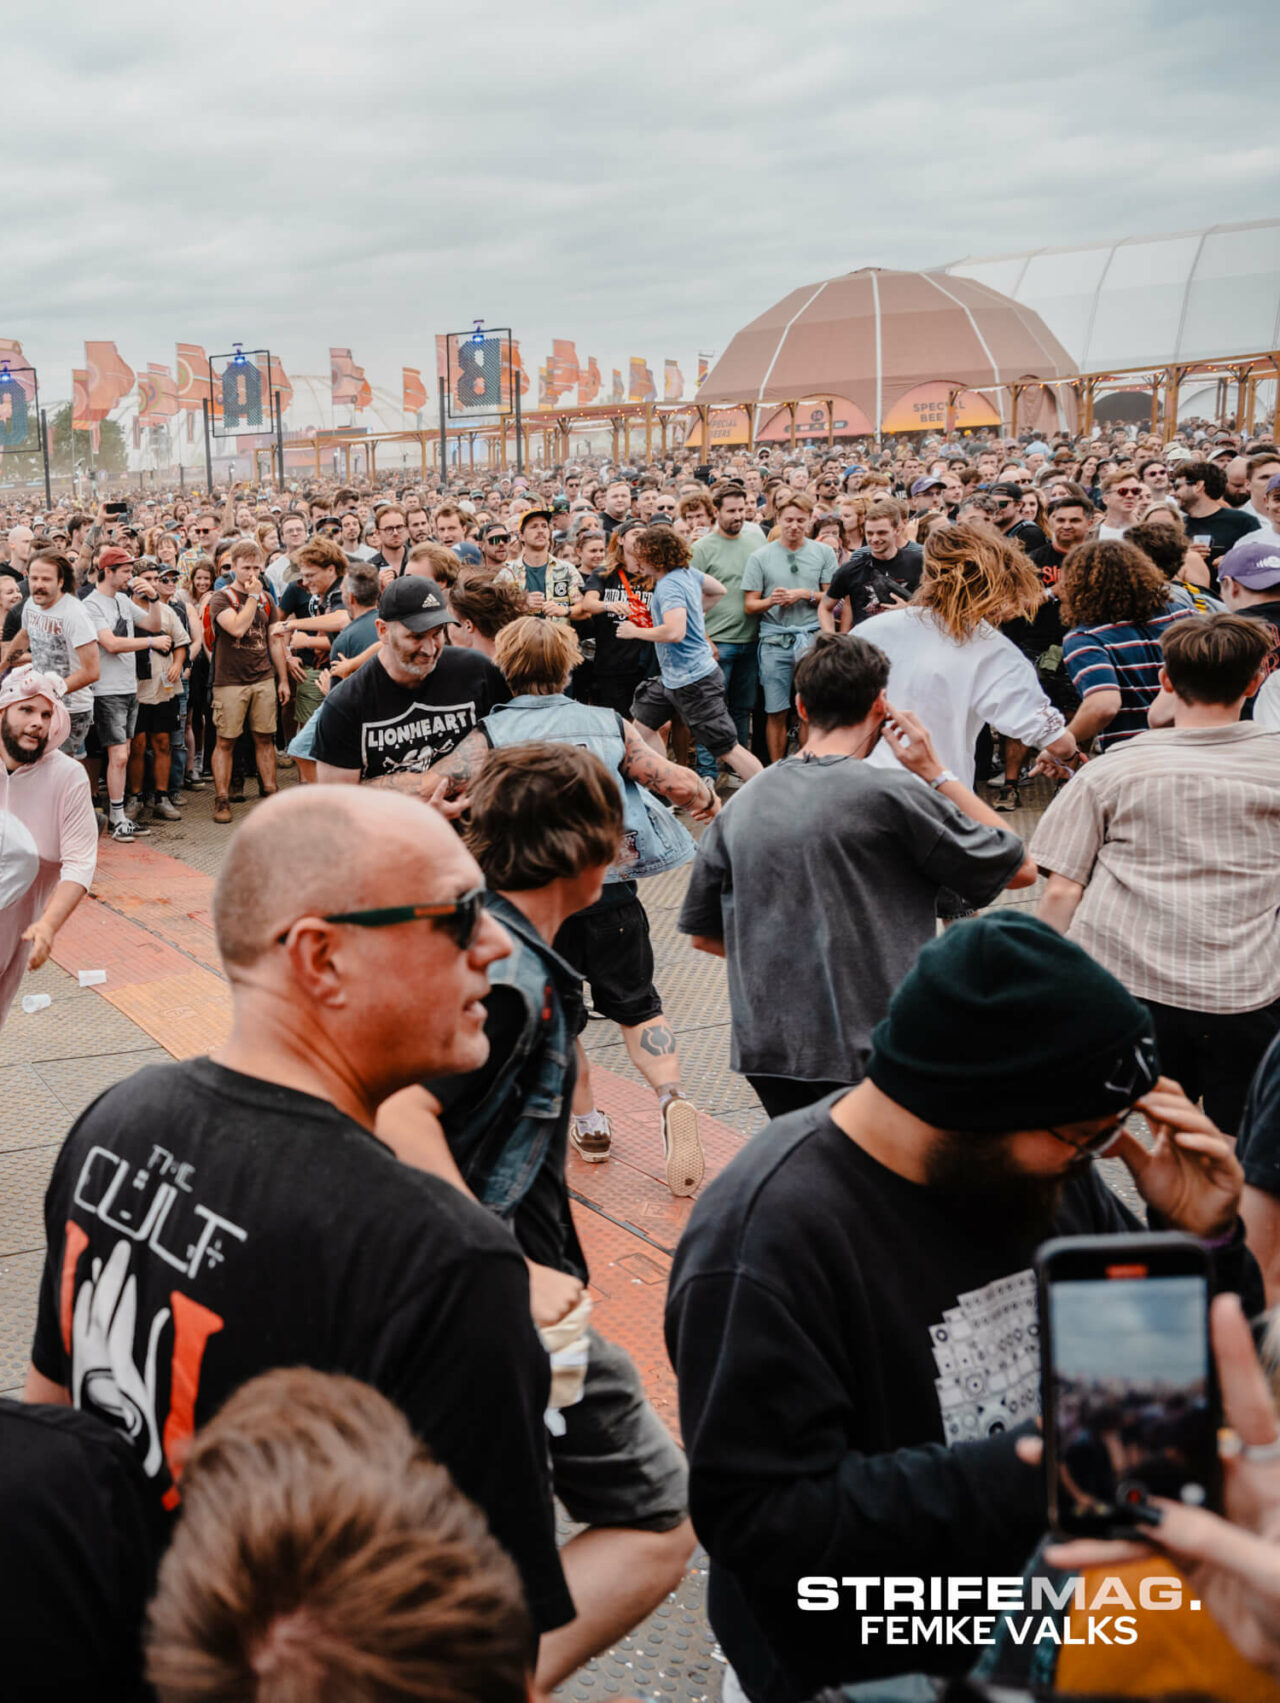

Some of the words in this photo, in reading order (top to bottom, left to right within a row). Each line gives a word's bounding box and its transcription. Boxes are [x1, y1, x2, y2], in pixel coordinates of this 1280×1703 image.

[913, 400, 966, 413] SPECL
[920, 412, 960, 423] BEE
[367, 711, 467, 748] LIONHEART
[147, 1144, 196, 1193] THE
[73, 1145, 248, 1279] CULT
